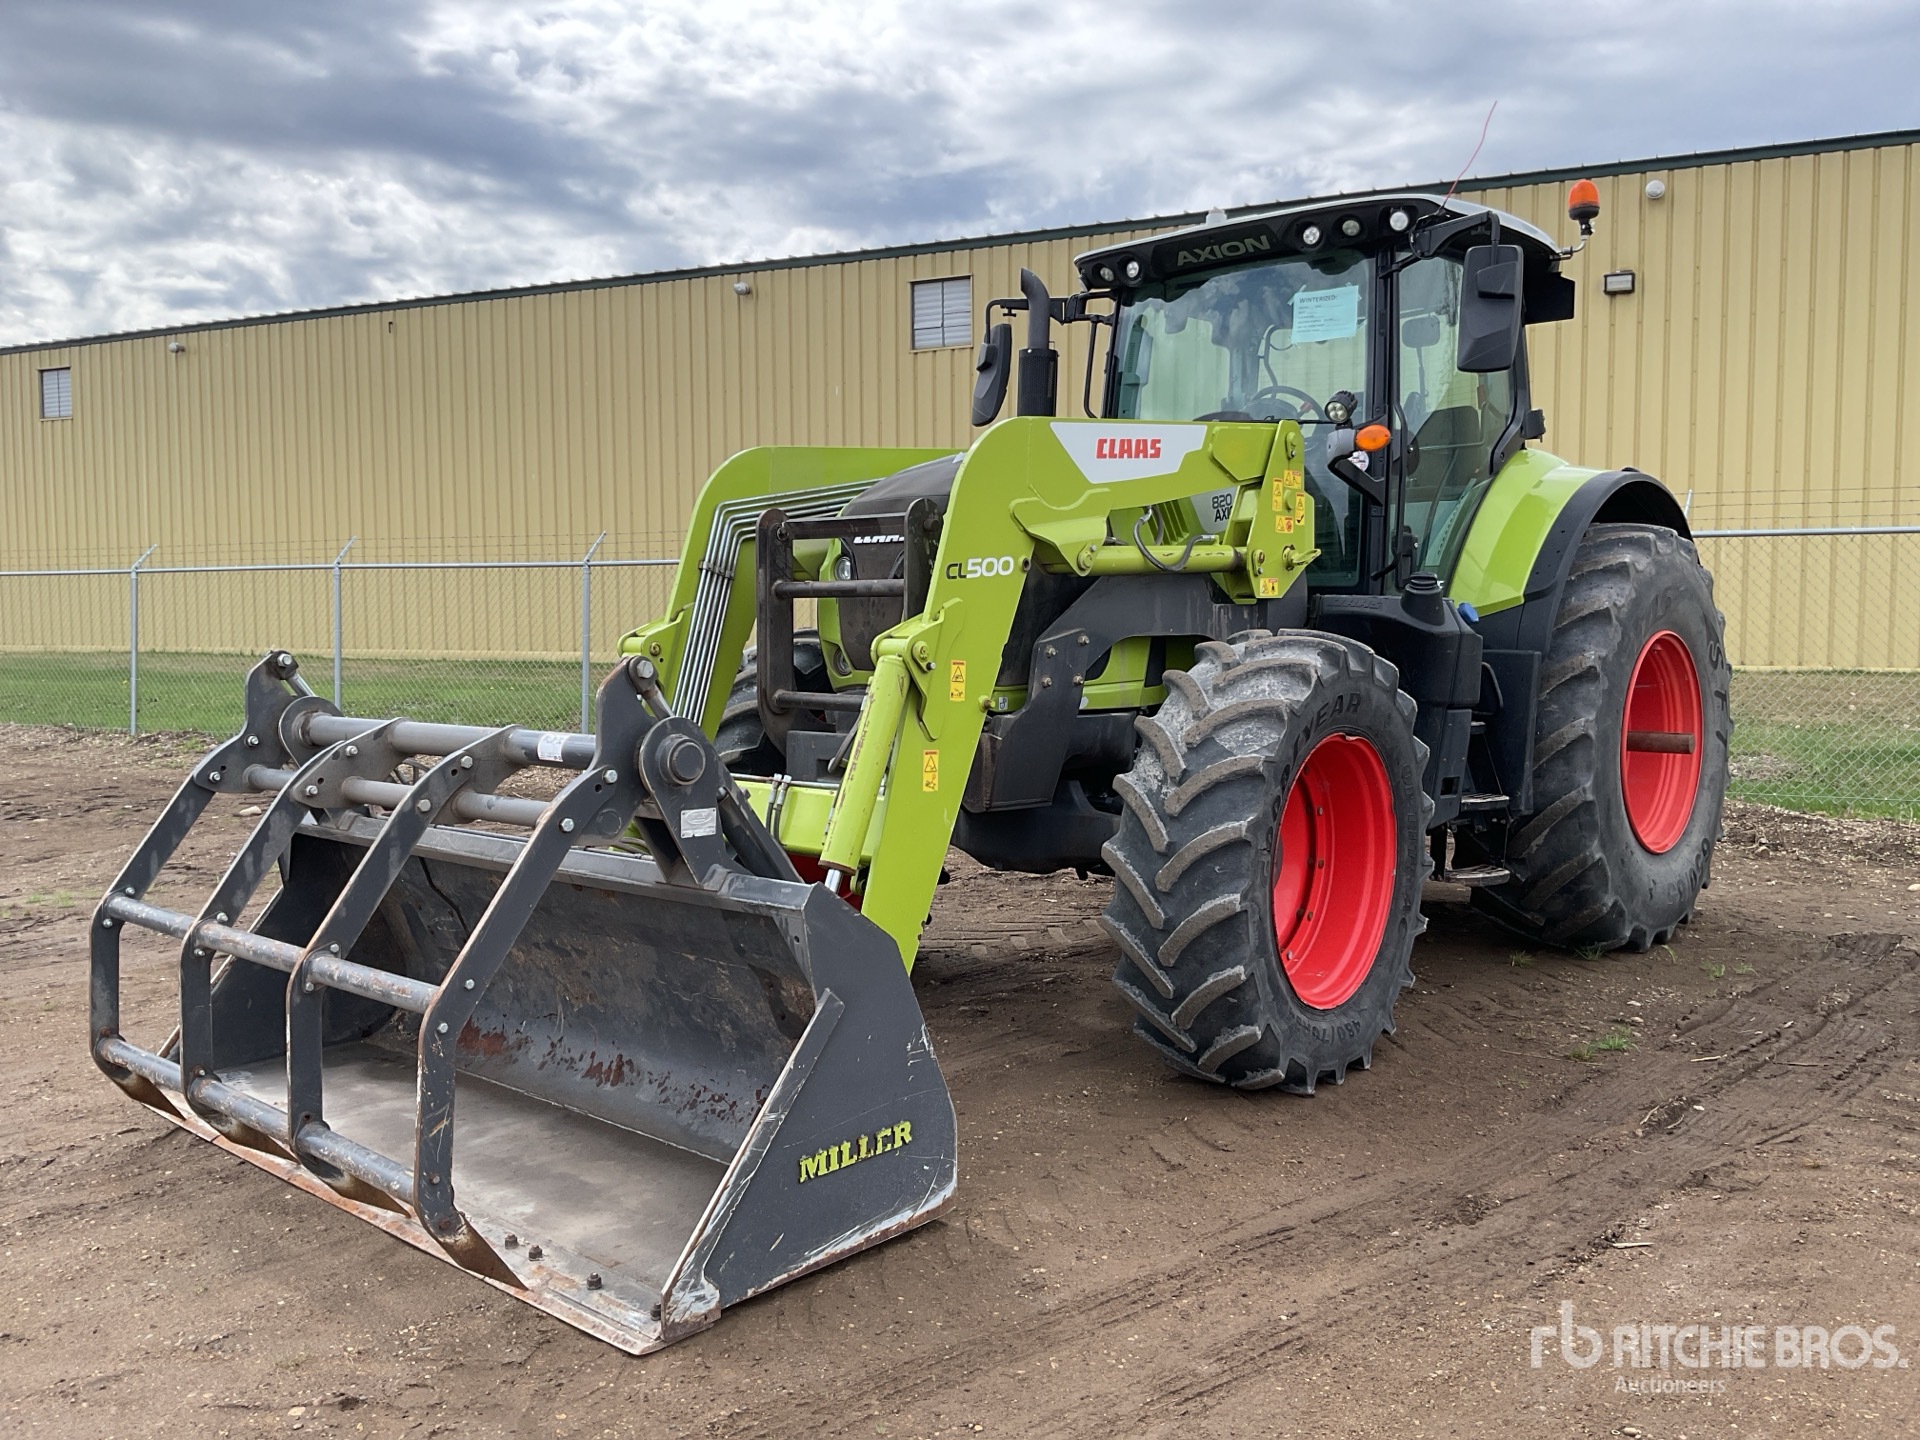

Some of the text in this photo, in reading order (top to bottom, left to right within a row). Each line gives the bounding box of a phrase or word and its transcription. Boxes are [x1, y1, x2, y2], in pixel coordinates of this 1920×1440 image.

[1177, 235, 1271, 266] AXION
[1095, 438, 1162, 459] CLAAS
[1211, 493, 1232, 509] 820
[946, 556, 1014, 580] CL500
[799, 1119, 913, 1184] MILLER
